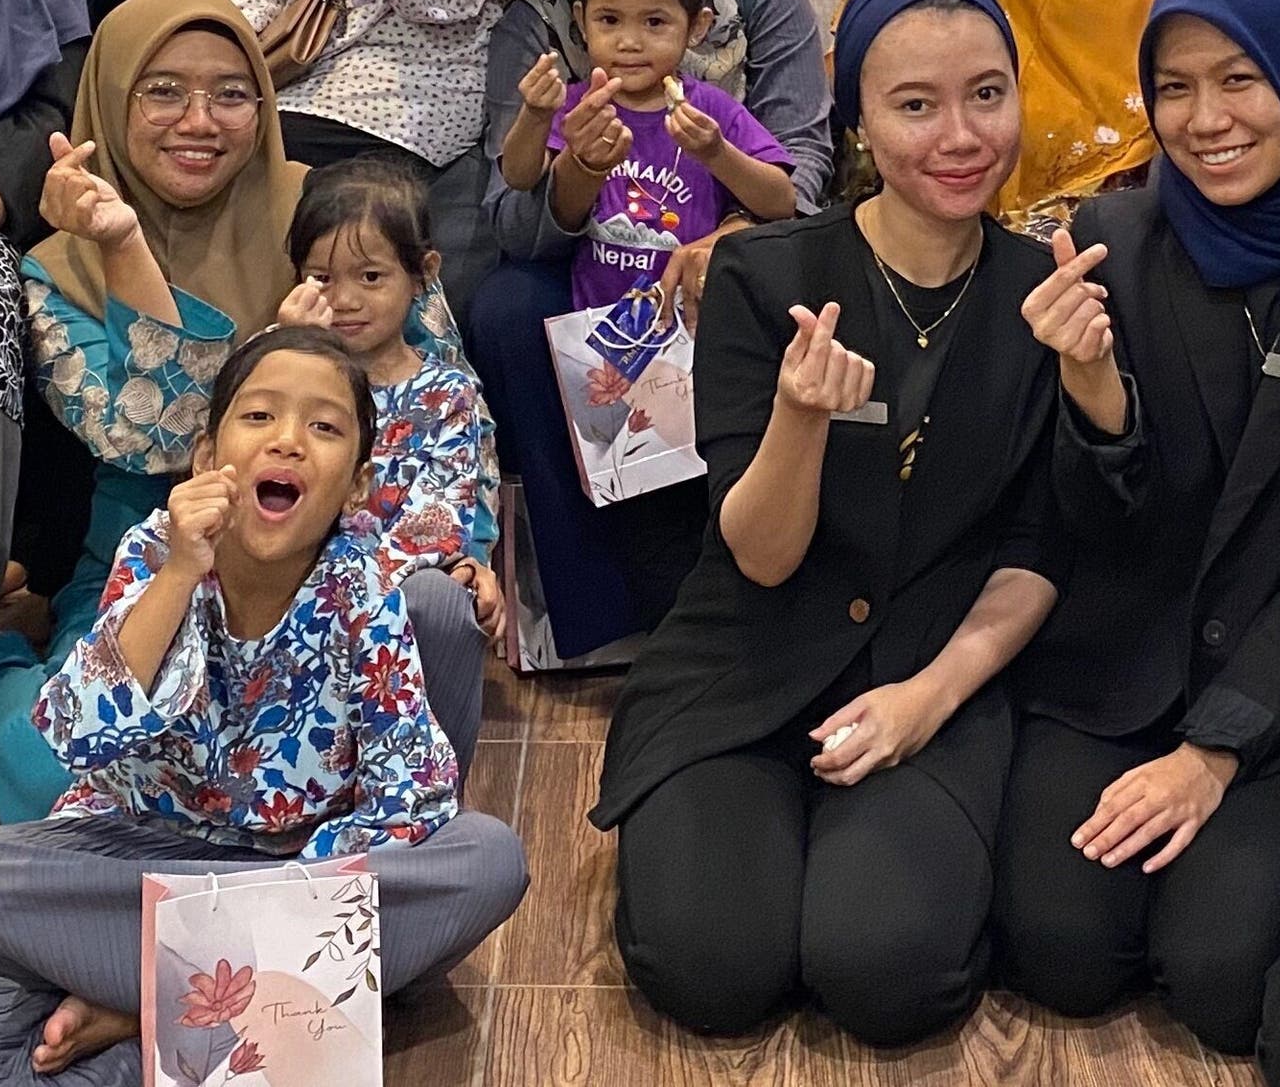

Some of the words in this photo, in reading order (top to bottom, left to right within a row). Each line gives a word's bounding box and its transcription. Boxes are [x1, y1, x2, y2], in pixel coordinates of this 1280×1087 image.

[593, 241, 657, 271] Nepal
[261, 1001, 329, 1025] Thank
[308, 1018, 347, 1041] You
